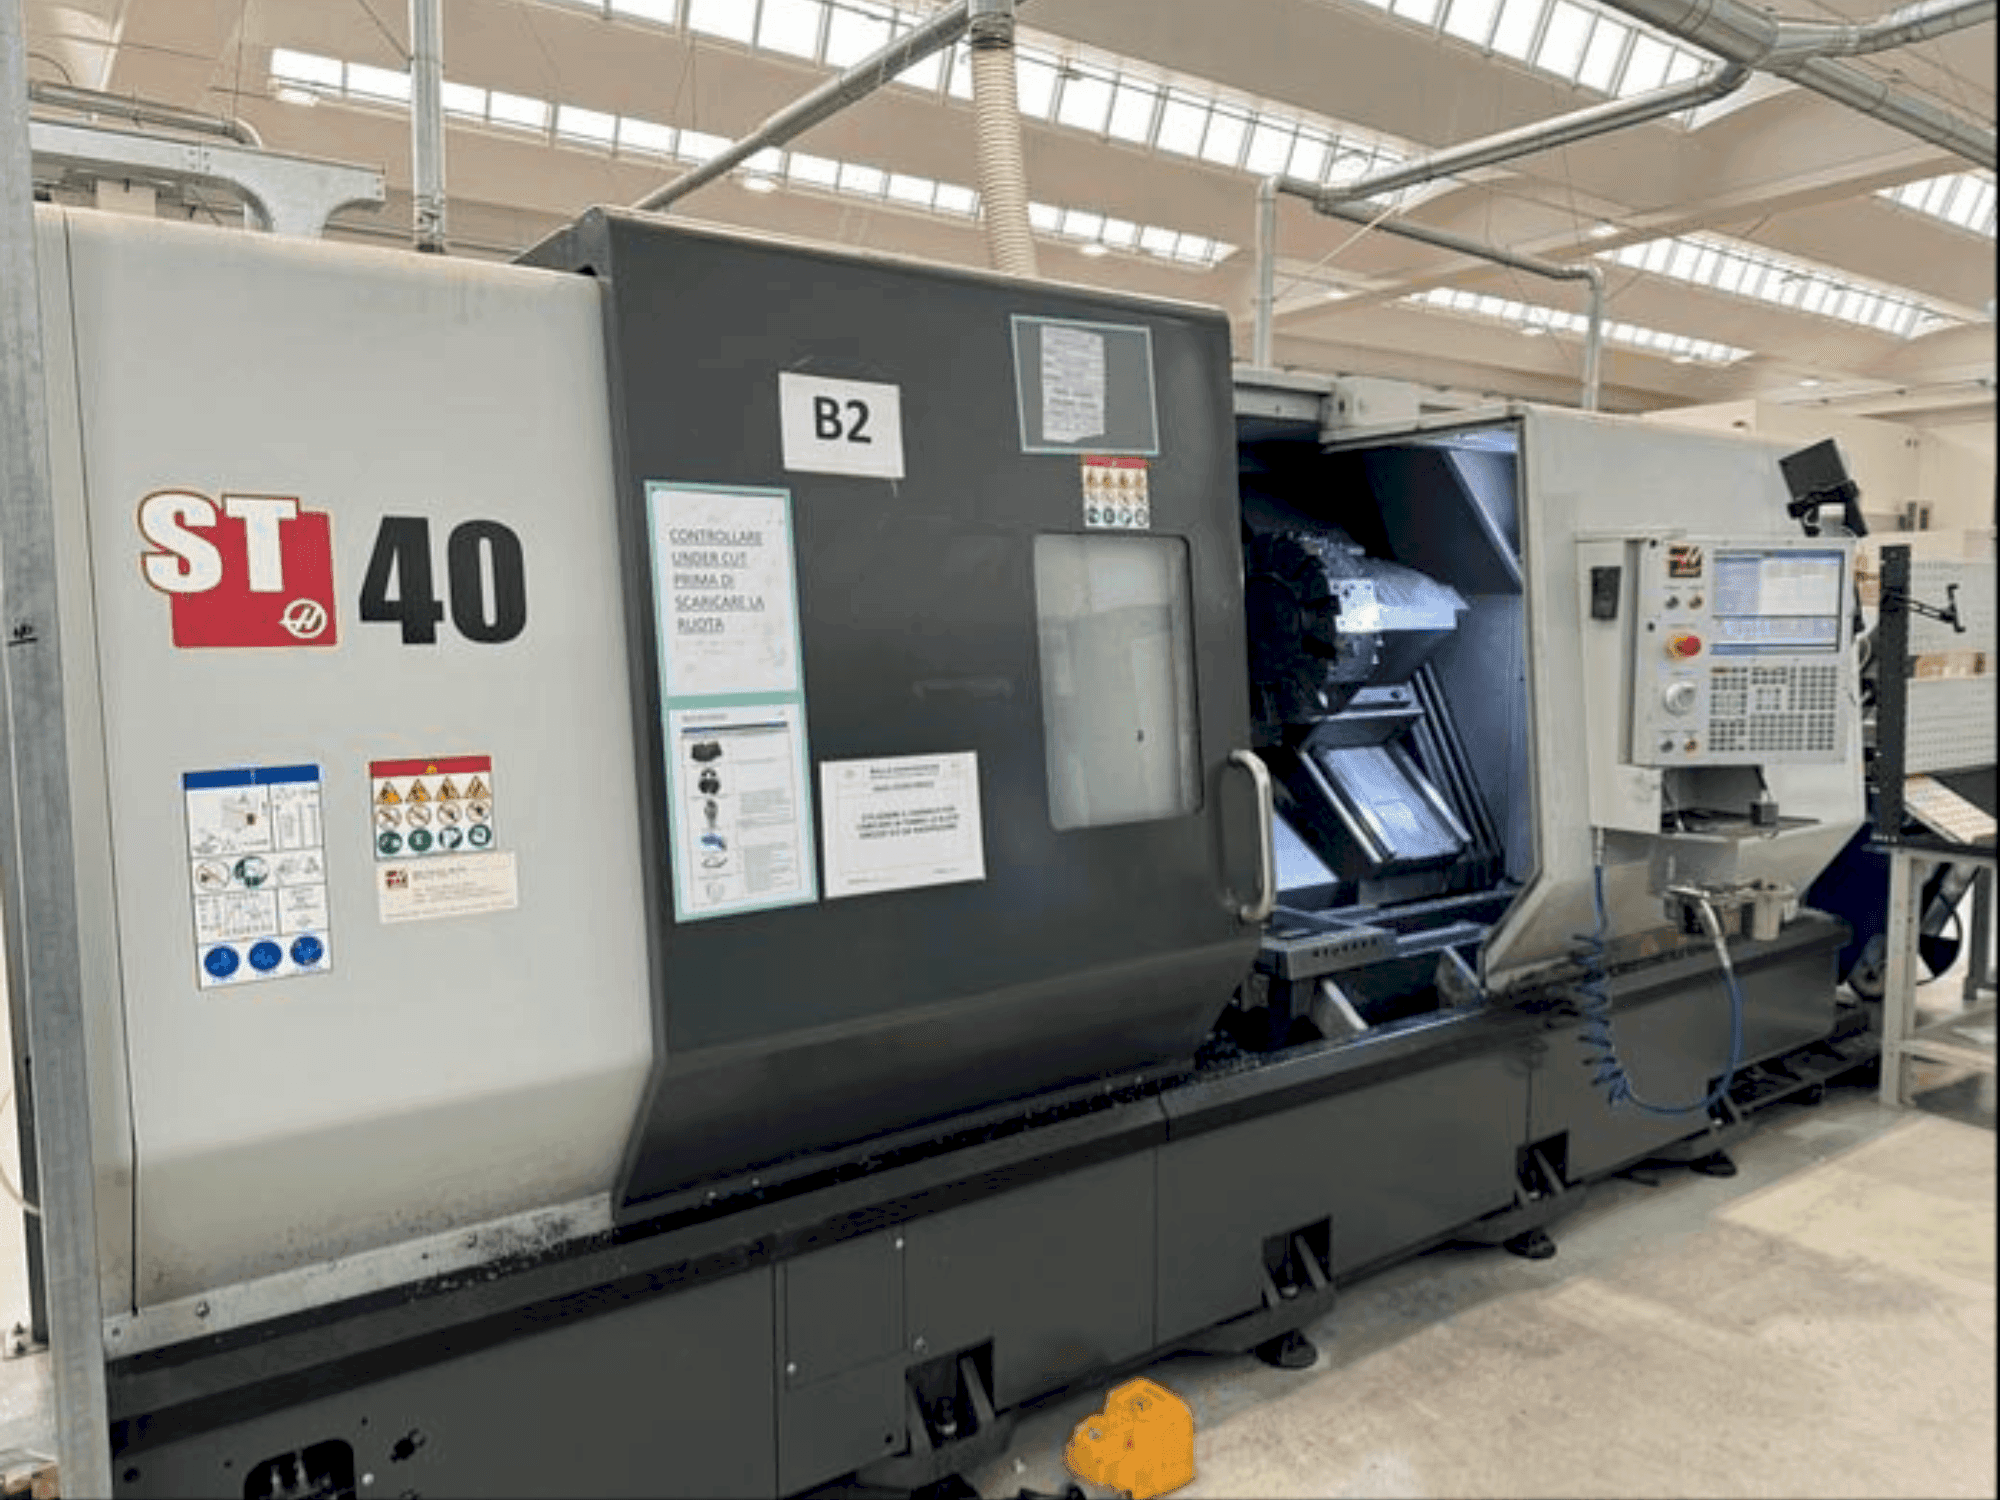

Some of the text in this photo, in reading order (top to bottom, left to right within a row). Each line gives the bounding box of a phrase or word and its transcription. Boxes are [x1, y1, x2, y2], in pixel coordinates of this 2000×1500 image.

[814, 397, 871, 443] B2
[669, 528, 762, 545] CONTROLLARE
[671, 550, 747, 567] UNDER CUT
[138, 491, 527, 645] ST 40
[674, 573, 735, 589] PRIMA DI
[675, 595, 764, 612] SCARICARE LA
[678, 617, 724, 634] RUOTA
